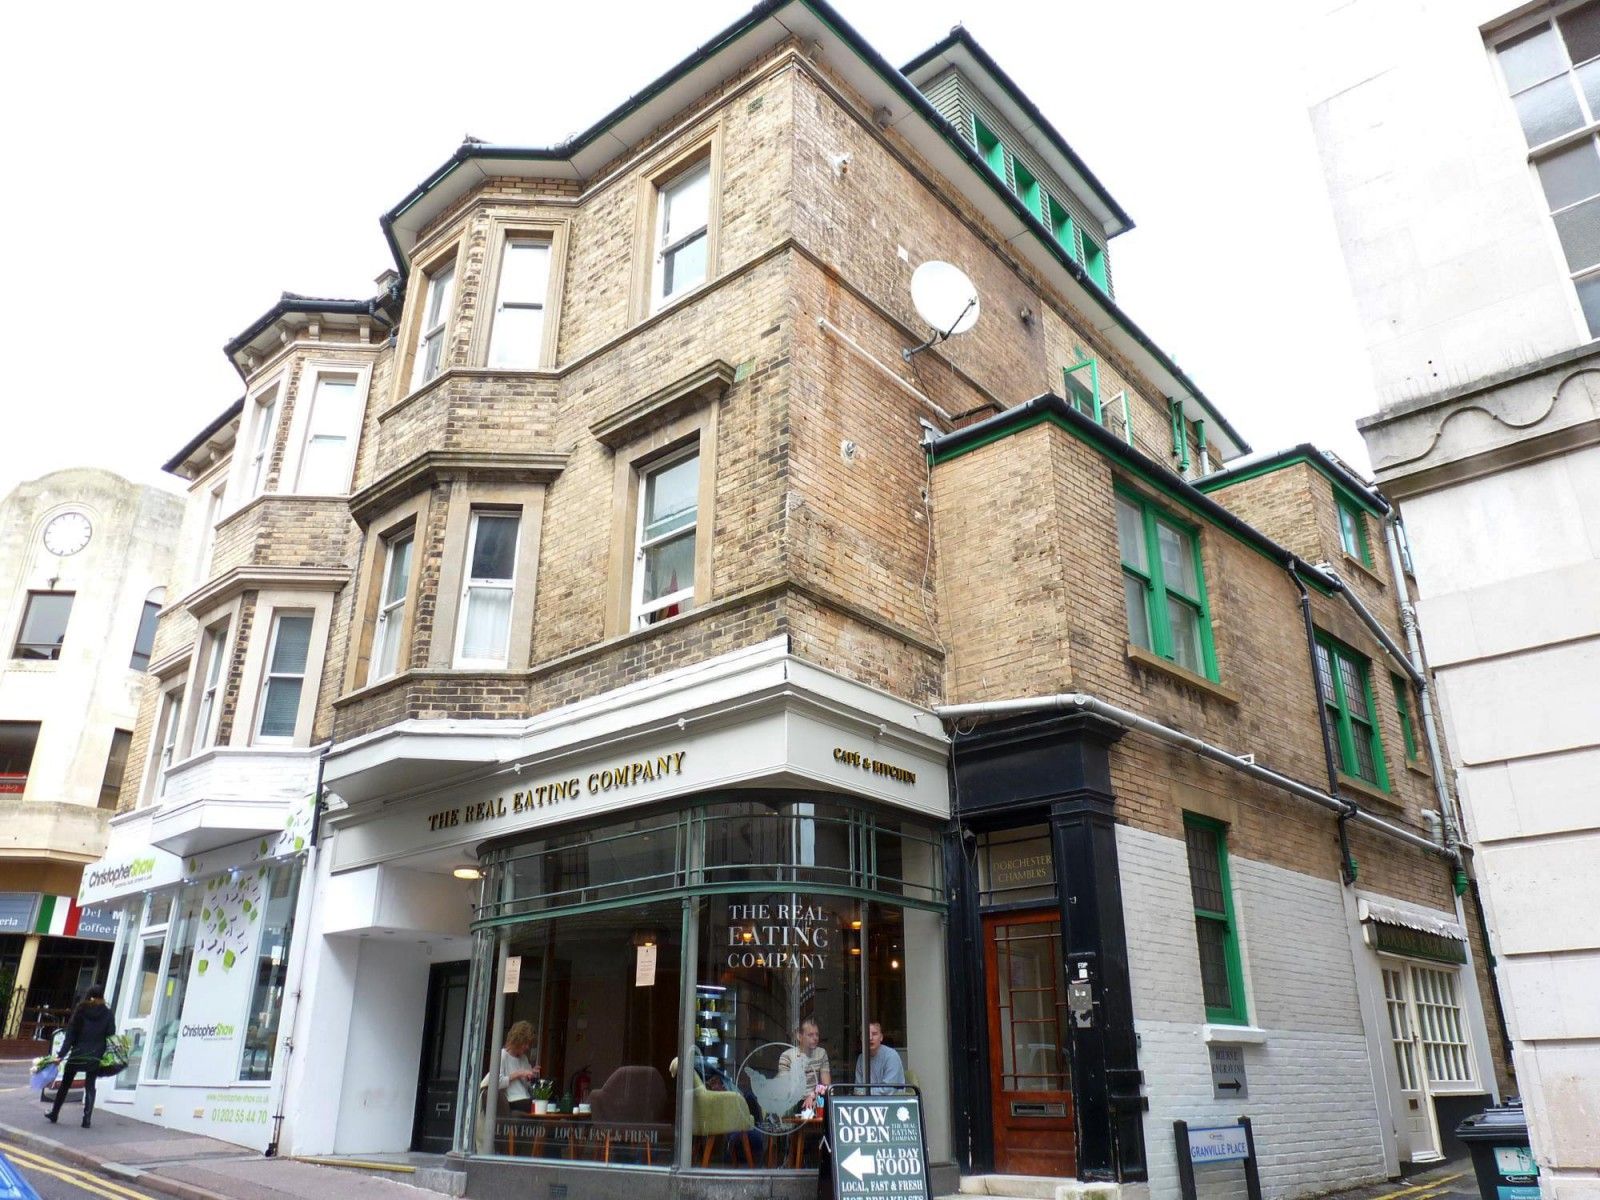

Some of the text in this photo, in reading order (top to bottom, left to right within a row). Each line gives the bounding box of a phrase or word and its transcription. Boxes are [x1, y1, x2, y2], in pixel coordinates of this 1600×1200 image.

[862, 758, 871, 769] &
[872, 760, 916, 785] KITCHEN
[428, 751, 686, 831] THE REAL EATING COMPANY
[993, 855, 1052, 872] DORCHESTER
[998, 868, 1047, 882] CHAMBERS
[728, 904, 829, 921] THE REAL
[79, 922, 111, 934] Coffee
[728, 926, 828, 948] EATING
[728, 953, 828, 969] COMPANY
[212, 1108, 268, 1124] 01202 55 44 70
[838, 1106, 889, 1126] NOW
[503, 1124, 518, 1136] DAY
[521, 1124, 546, 1137] FOOD
[554, 1126, 587, 1142] LOCAL,
[589, 1128, 611, 1142] FAST
[612, 1130, 621, 1142] &
[625, 1129, 658, 1143] FRESH
[839, 1126, 890, 1143] OPEN
[875, 1148, 919, 1159] ALL DAY
[1191, 1142, 1246, 1157] GRANVILLE PLACE
[876, 1158, 921, 1175] FOOD
[841, 1180, 923, 1193] LOCAL, FAST & FRESH
